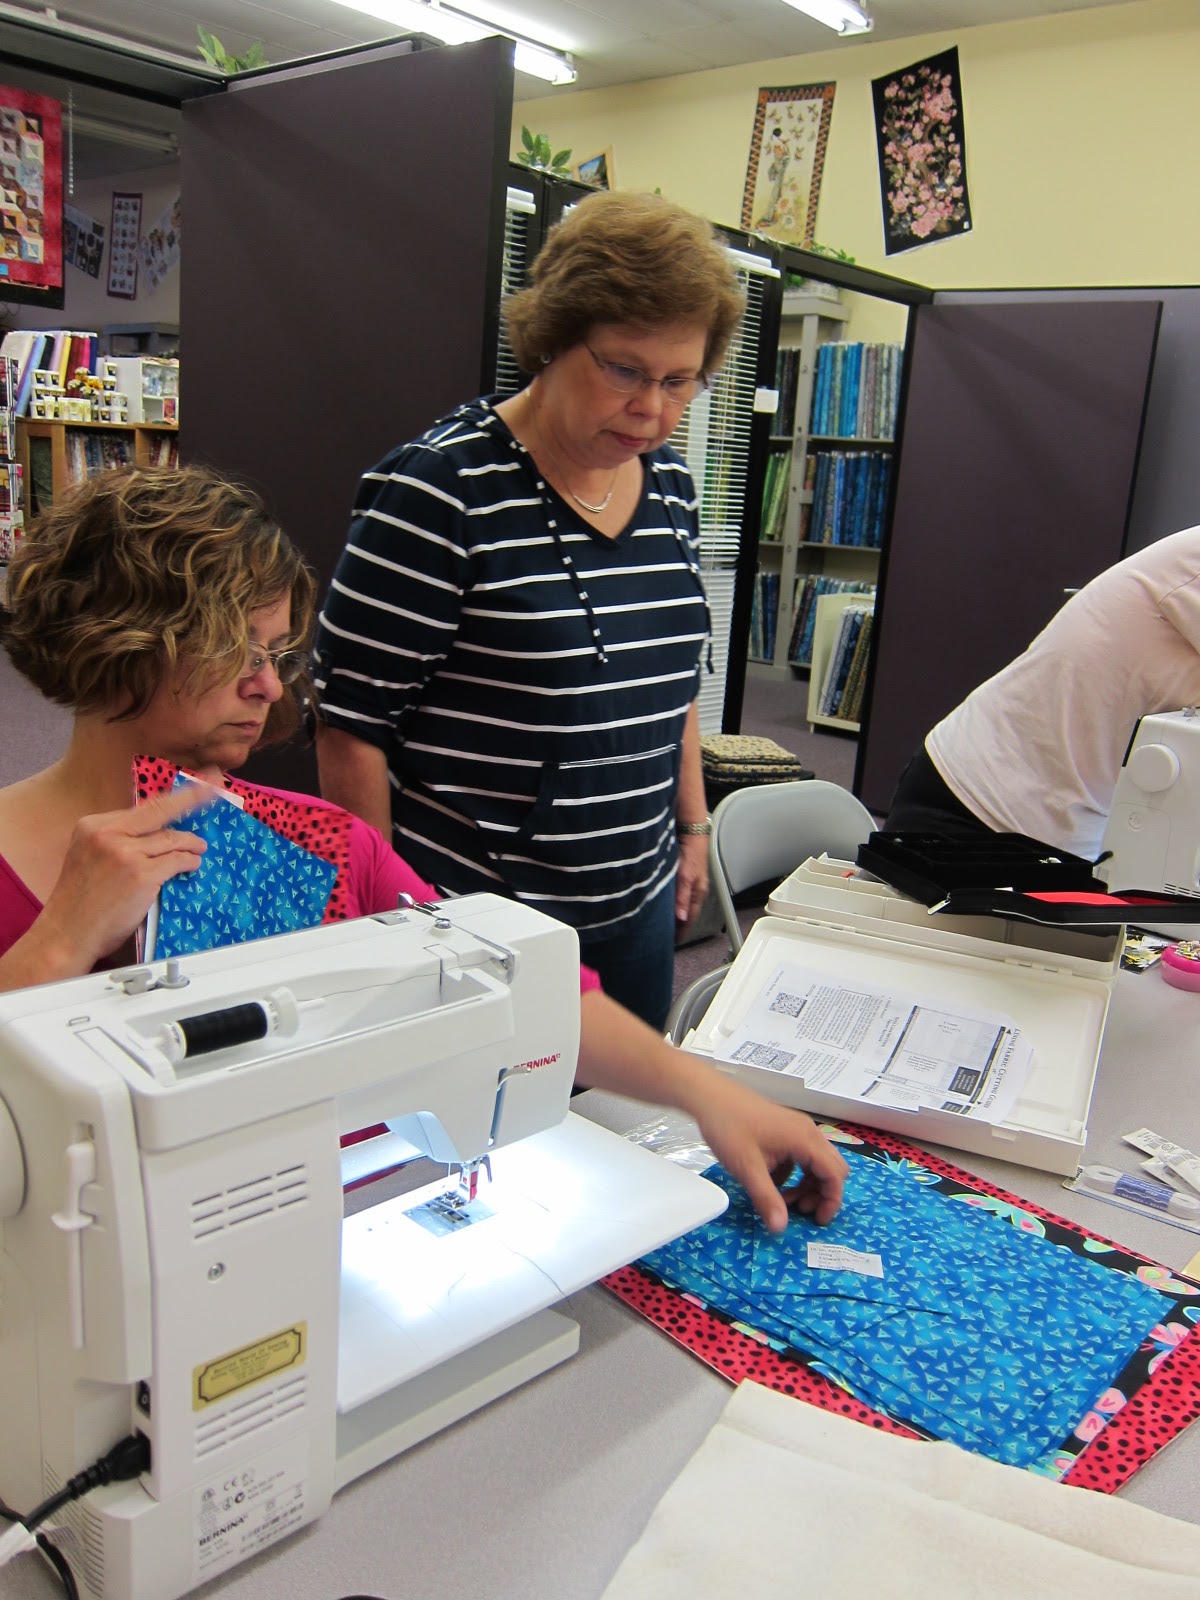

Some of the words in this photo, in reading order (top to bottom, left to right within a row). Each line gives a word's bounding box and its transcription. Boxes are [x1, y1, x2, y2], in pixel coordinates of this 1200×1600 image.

[513, 1053, 557, 1069] RNINA
[990, 1068, 1007, 1096] CUTTING
[199, 1517, 245, 1546] BERNINA
